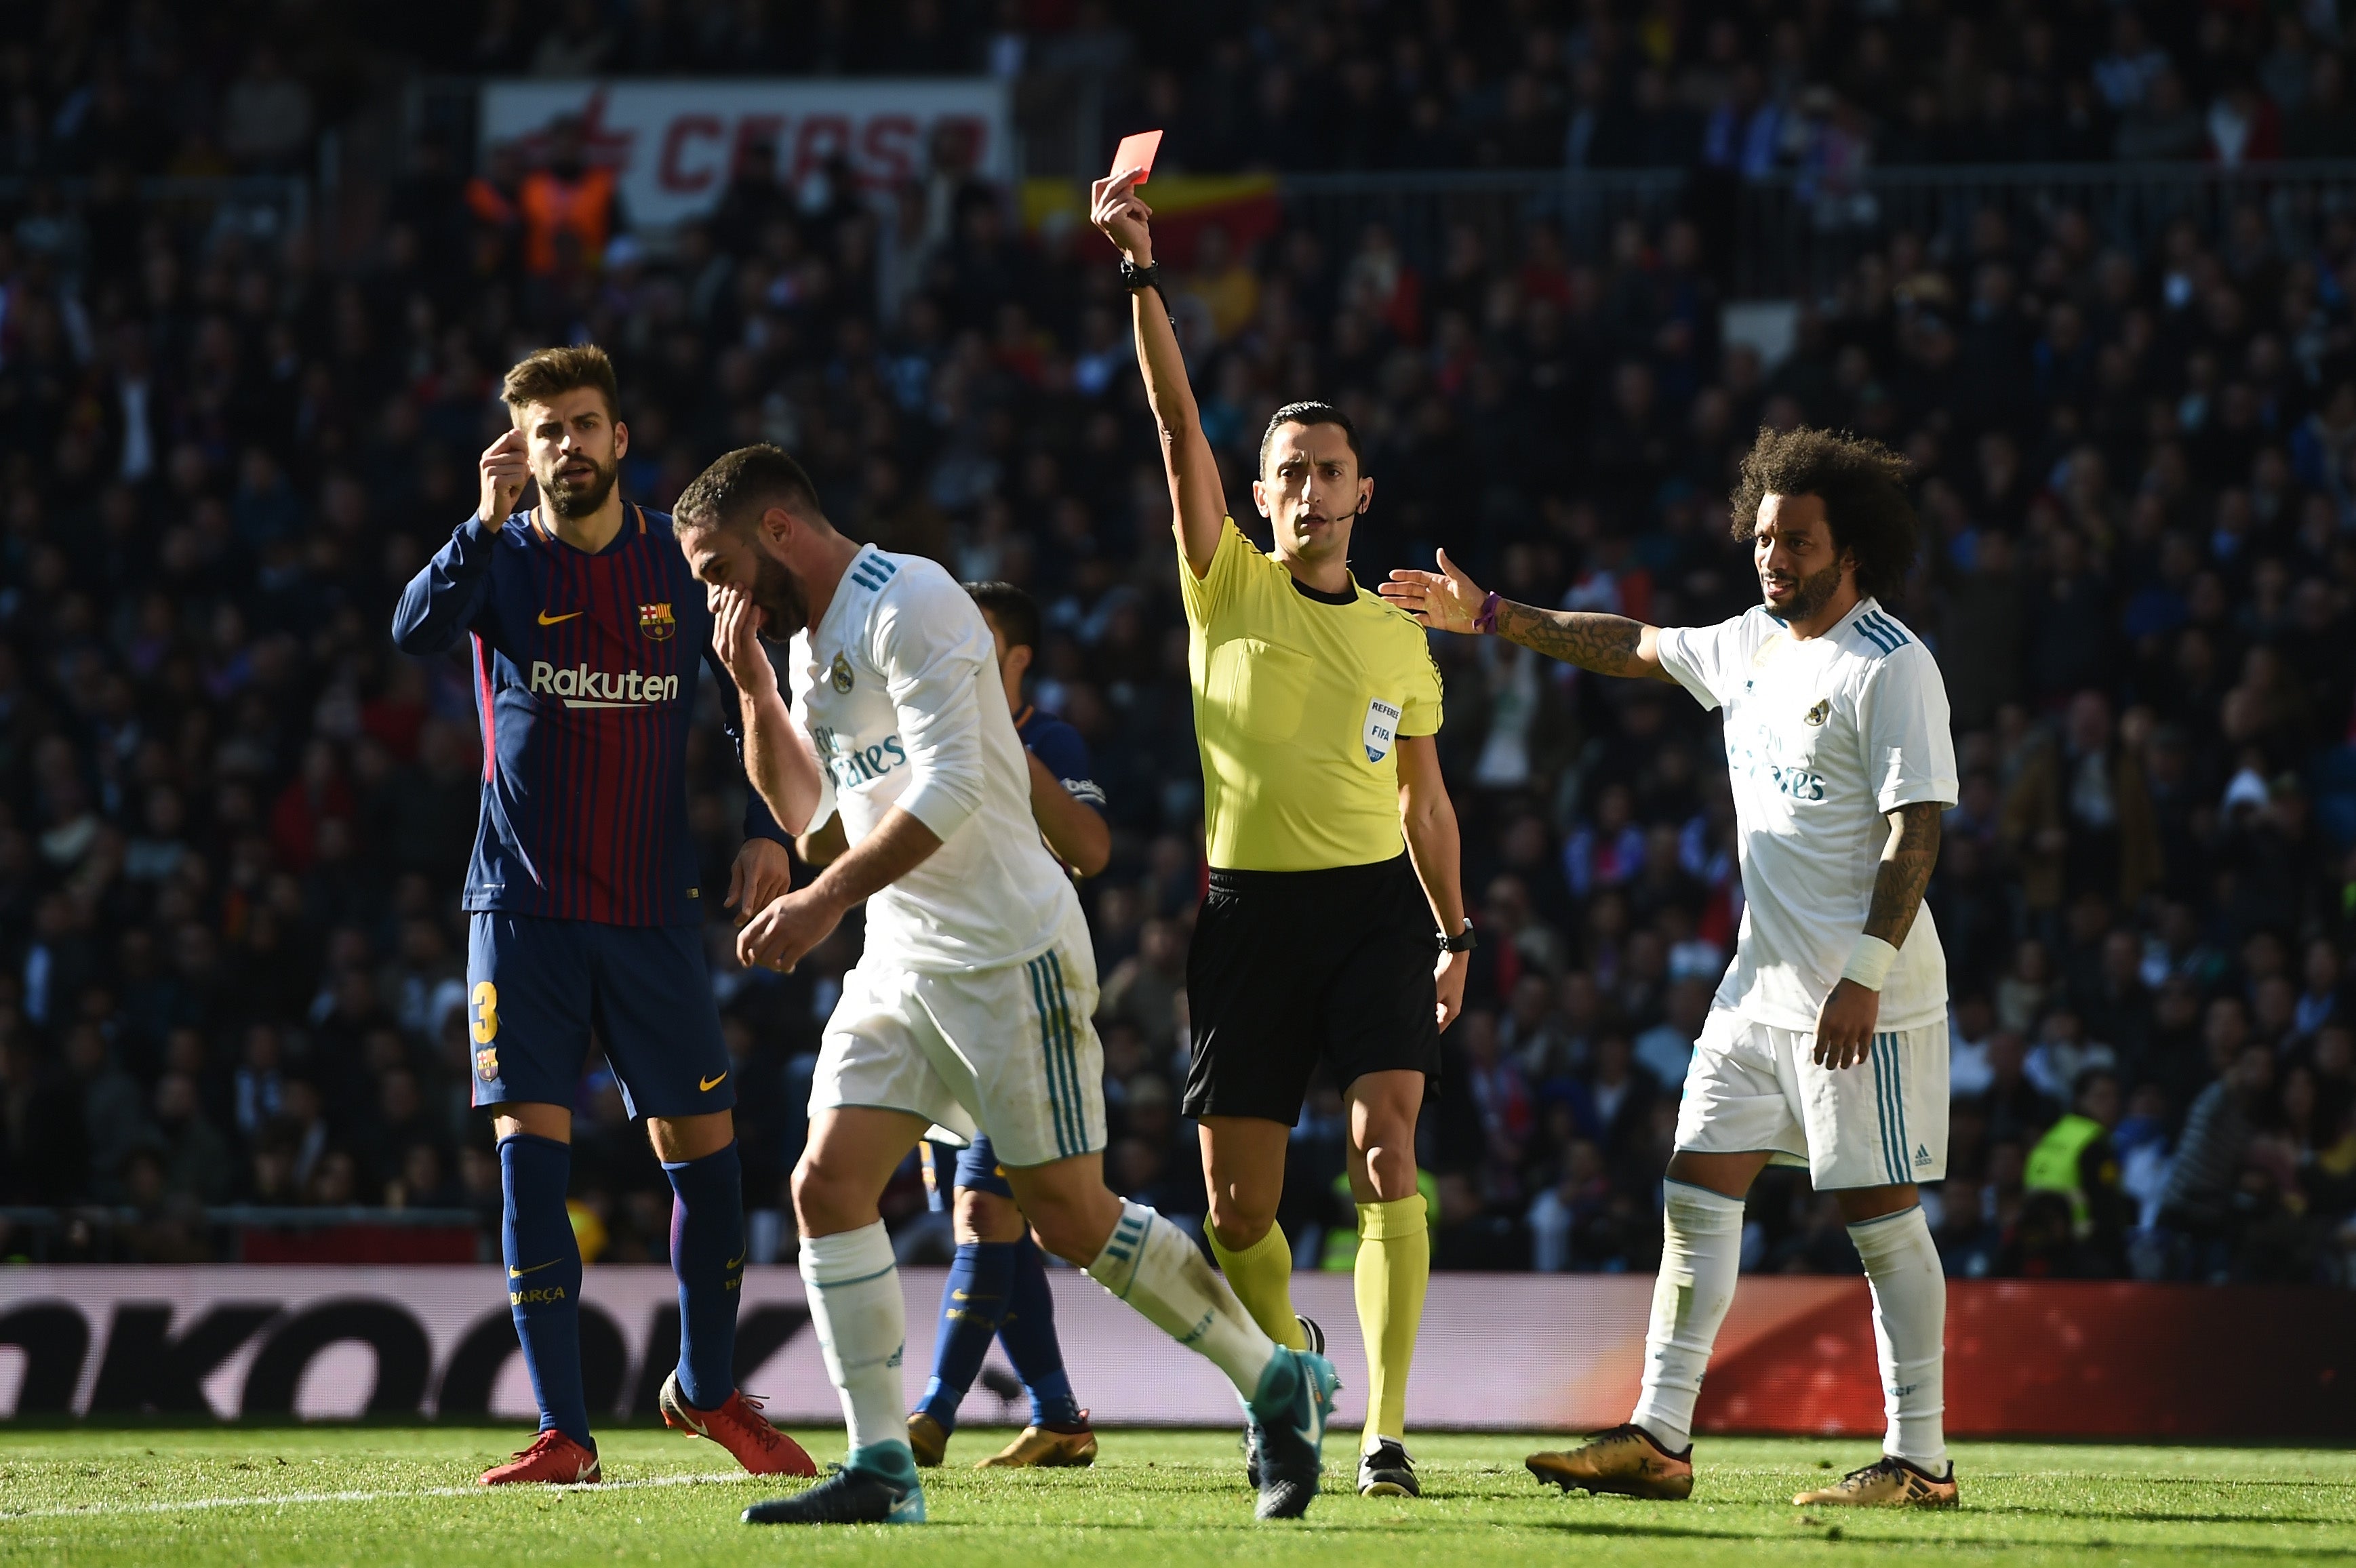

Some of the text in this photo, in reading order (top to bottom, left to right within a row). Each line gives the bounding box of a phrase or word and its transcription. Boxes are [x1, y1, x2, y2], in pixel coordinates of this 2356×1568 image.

[531, 660, 679, 702] Rakuten
[1372, 702, 1399, 719] REFEREE
[1372, 725, 1390, 742] FIFA
[472, 981, 498, 1045] 3
[510, 1286, 565, 1305] BARÇA
